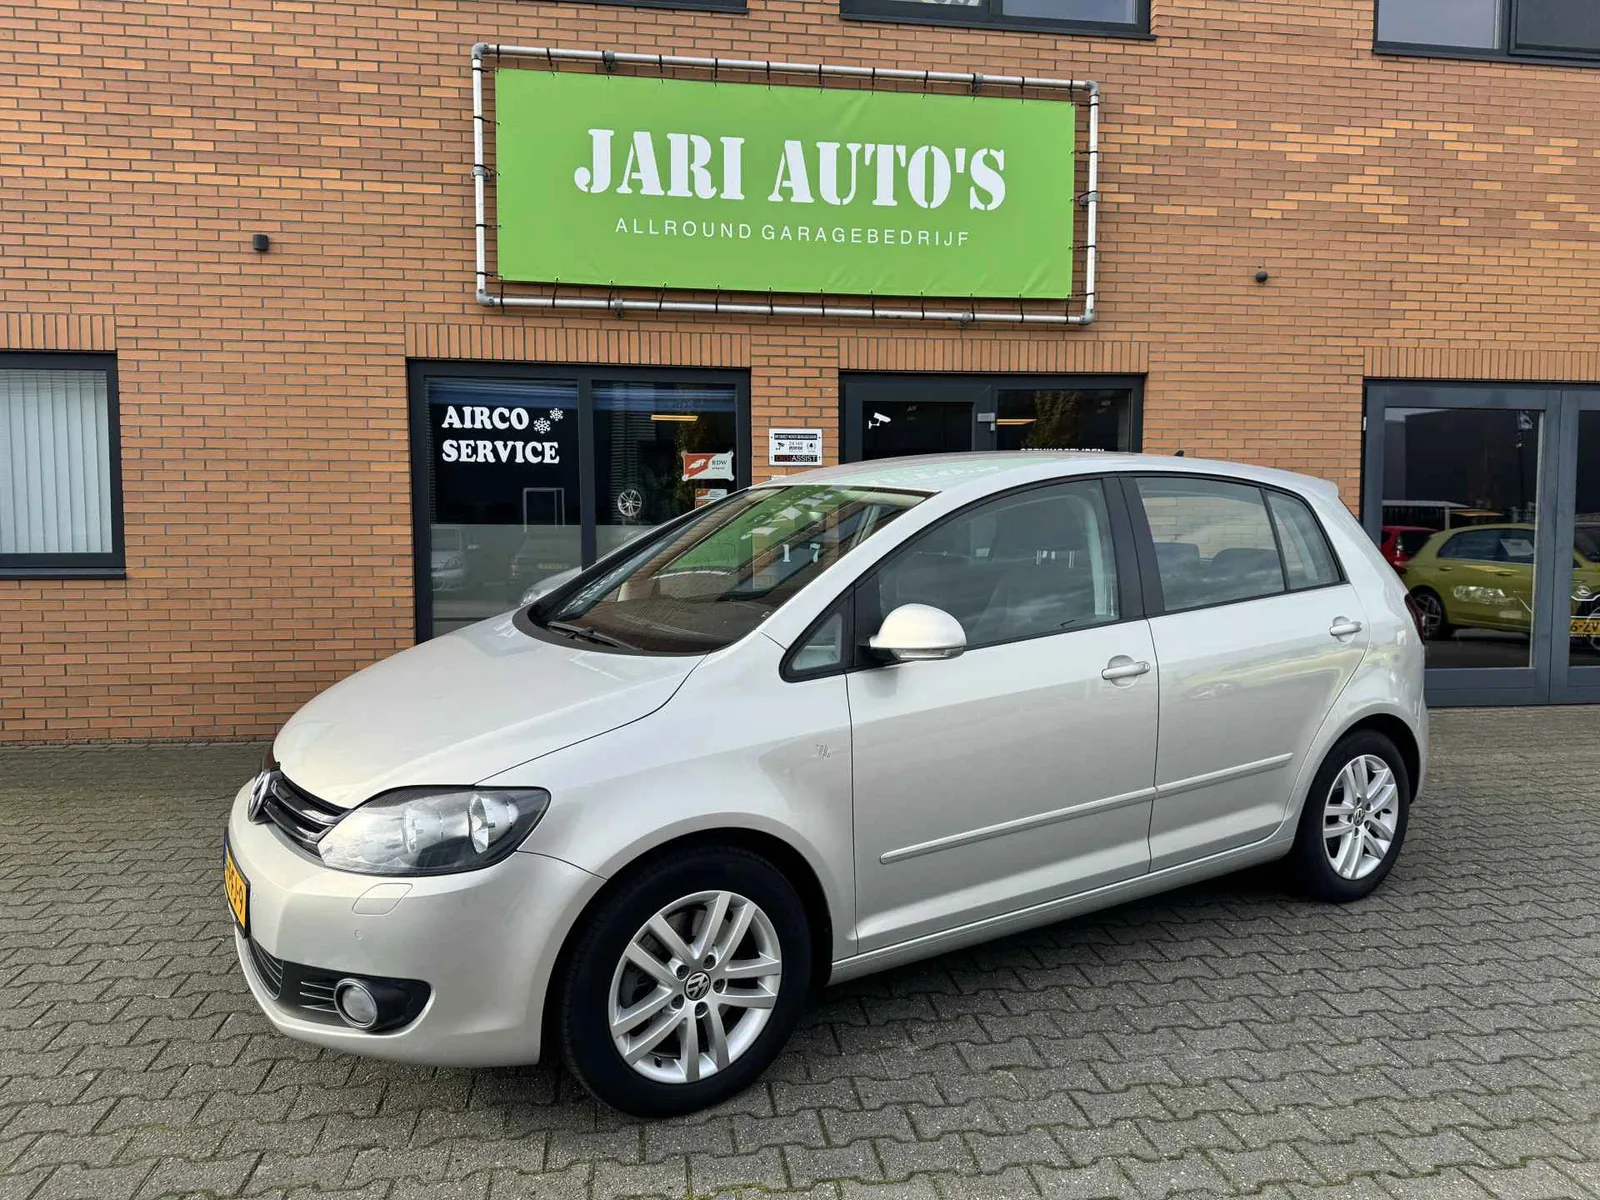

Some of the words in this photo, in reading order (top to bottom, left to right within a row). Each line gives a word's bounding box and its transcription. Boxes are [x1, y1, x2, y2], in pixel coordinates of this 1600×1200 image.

[573, 128, 746, 201] JARI
[767, 139, 1006, 212] AUTO'S
[615, 217, 751, 240] ALLROUND
[761, 224, 970, 247] GARAGEBEDRIJF
[441, 405, 530, 430] AIRCO
[441, 439, 560, 464] SERVICE
